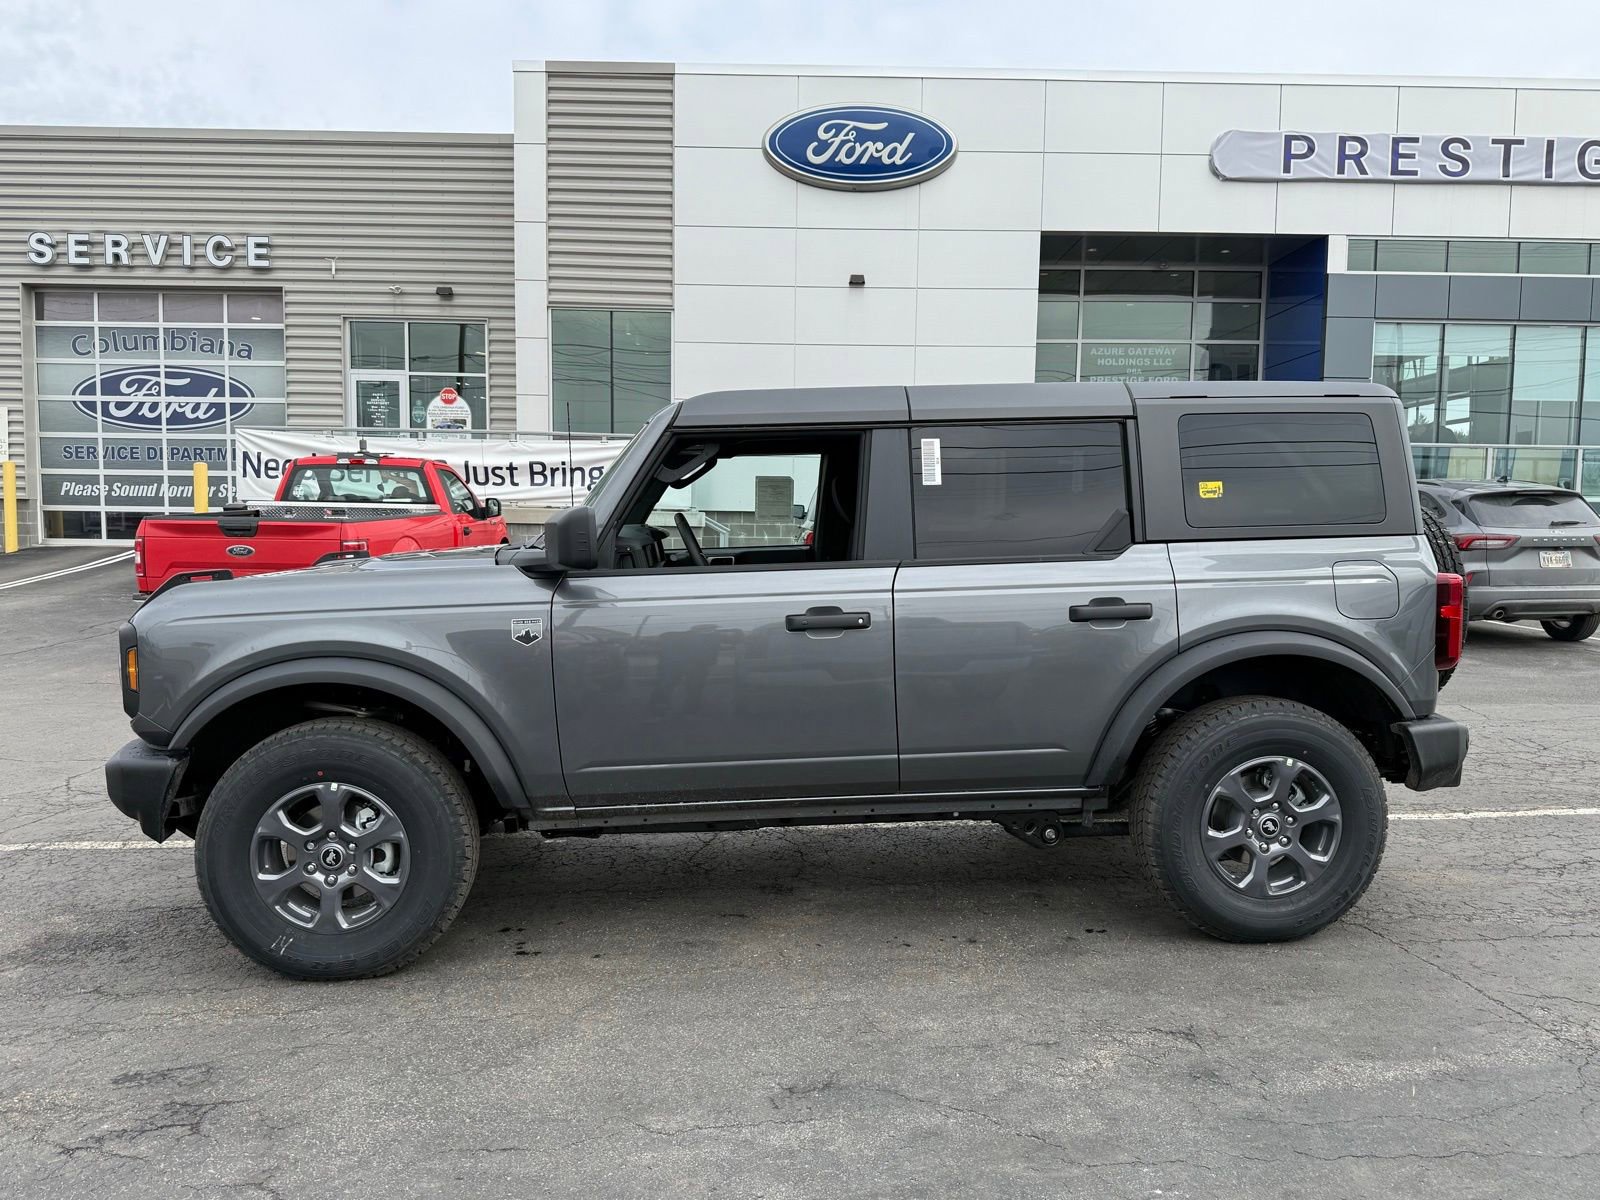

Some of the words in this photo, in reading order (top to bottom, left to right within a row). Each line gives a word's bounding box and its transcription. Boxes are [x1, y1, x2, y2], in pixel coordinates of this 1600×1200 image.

[806, 119, 916, 165] Ford
[27, 231, 272, 268] SERVICE
[71, 329, 254, 360] Columbiana
[1090, 347, 1125, 356] AZURE
[1128, 347, 1177, 356] GATEWAY
[1097, 358, 1151, 366] HOLDINGS
[1153, 358, 1173, 366] LLC
[108, 374, 219, 420] Ford
[62, 445, 141, 460] SERVICE
[146, 446, 237, 461] DEPARTM
[60, 481, 108, 496] Please
[111, 482, 159, 497] Sound
[463, 460, 520, 487] Just
[529, 460, 605, 492] Bring
